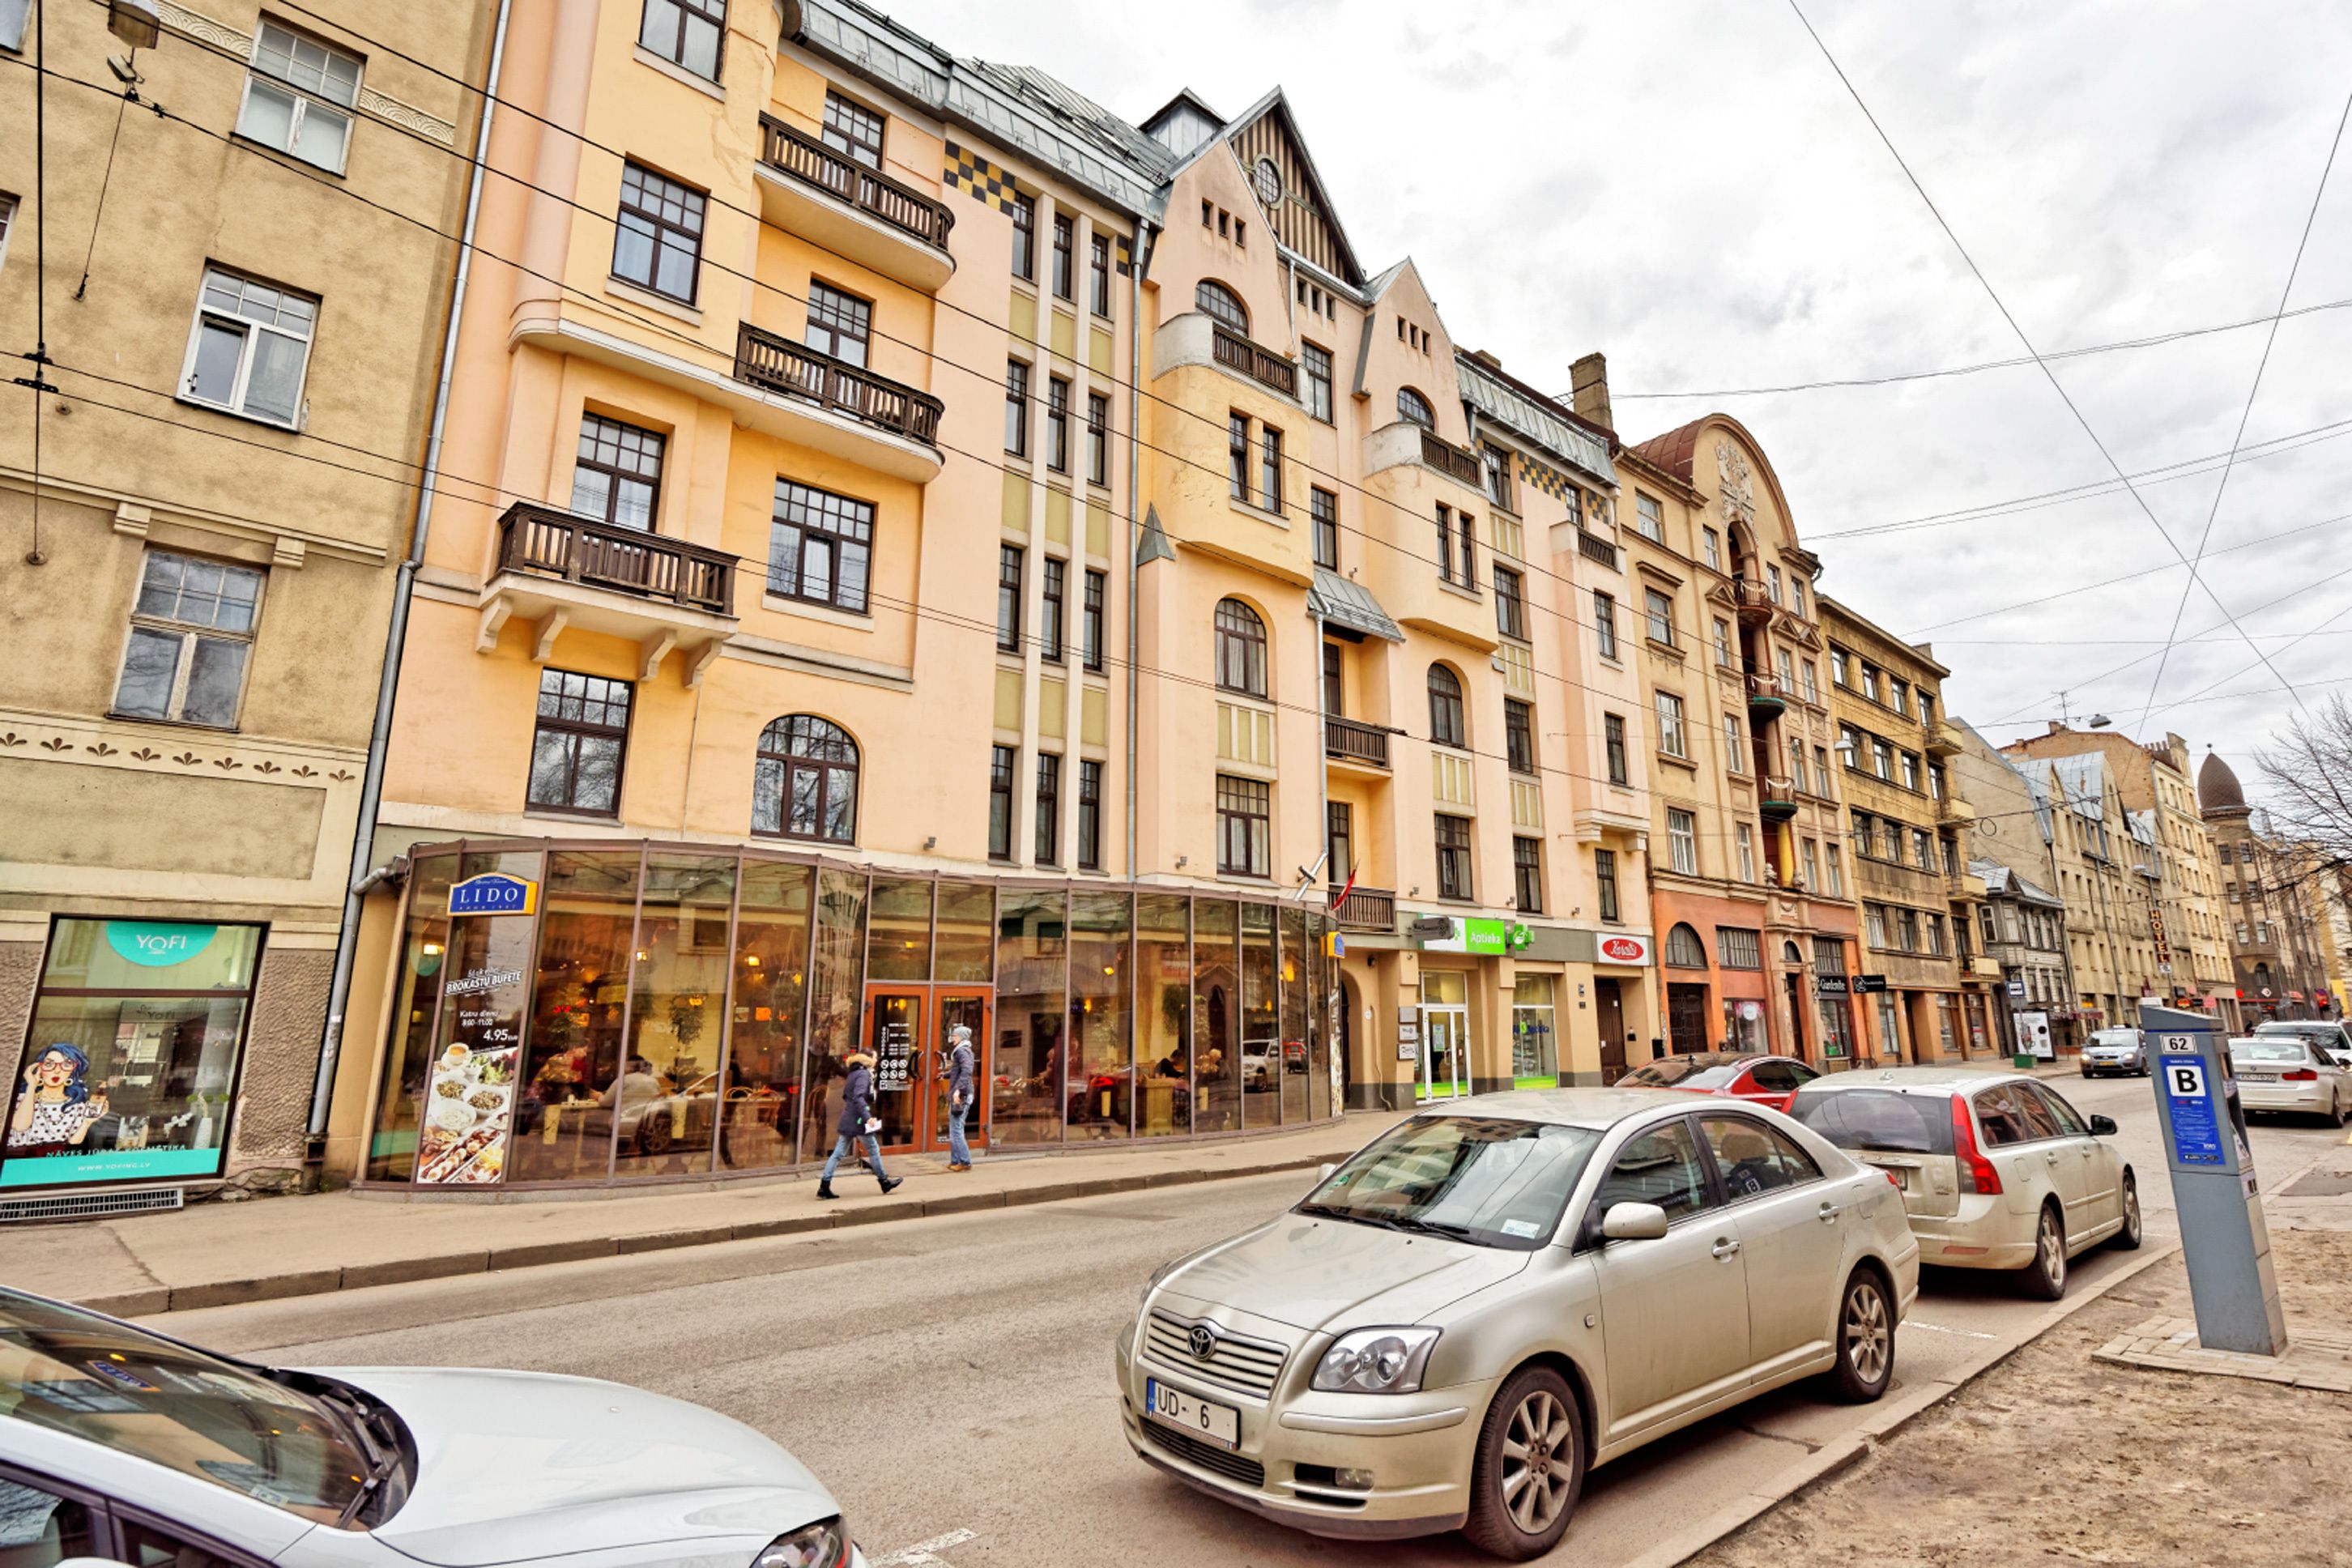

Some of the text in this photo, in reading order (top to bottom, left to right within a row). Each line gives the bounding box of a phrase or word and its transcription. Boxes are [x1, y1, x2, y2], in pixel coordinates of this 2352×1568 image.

[460, 888, 518, 904] LIDO
[136, 934, 187, 953] YOFI
[1471, 932, 1502, 946] Aptieka
[2150, 910, 2171, 964] HOTEL
[484, 1029, 509, 1041] 4.95
[2170, 1038, 2188, 1050] 62
[2175, 1069, 2197, 1093] B
